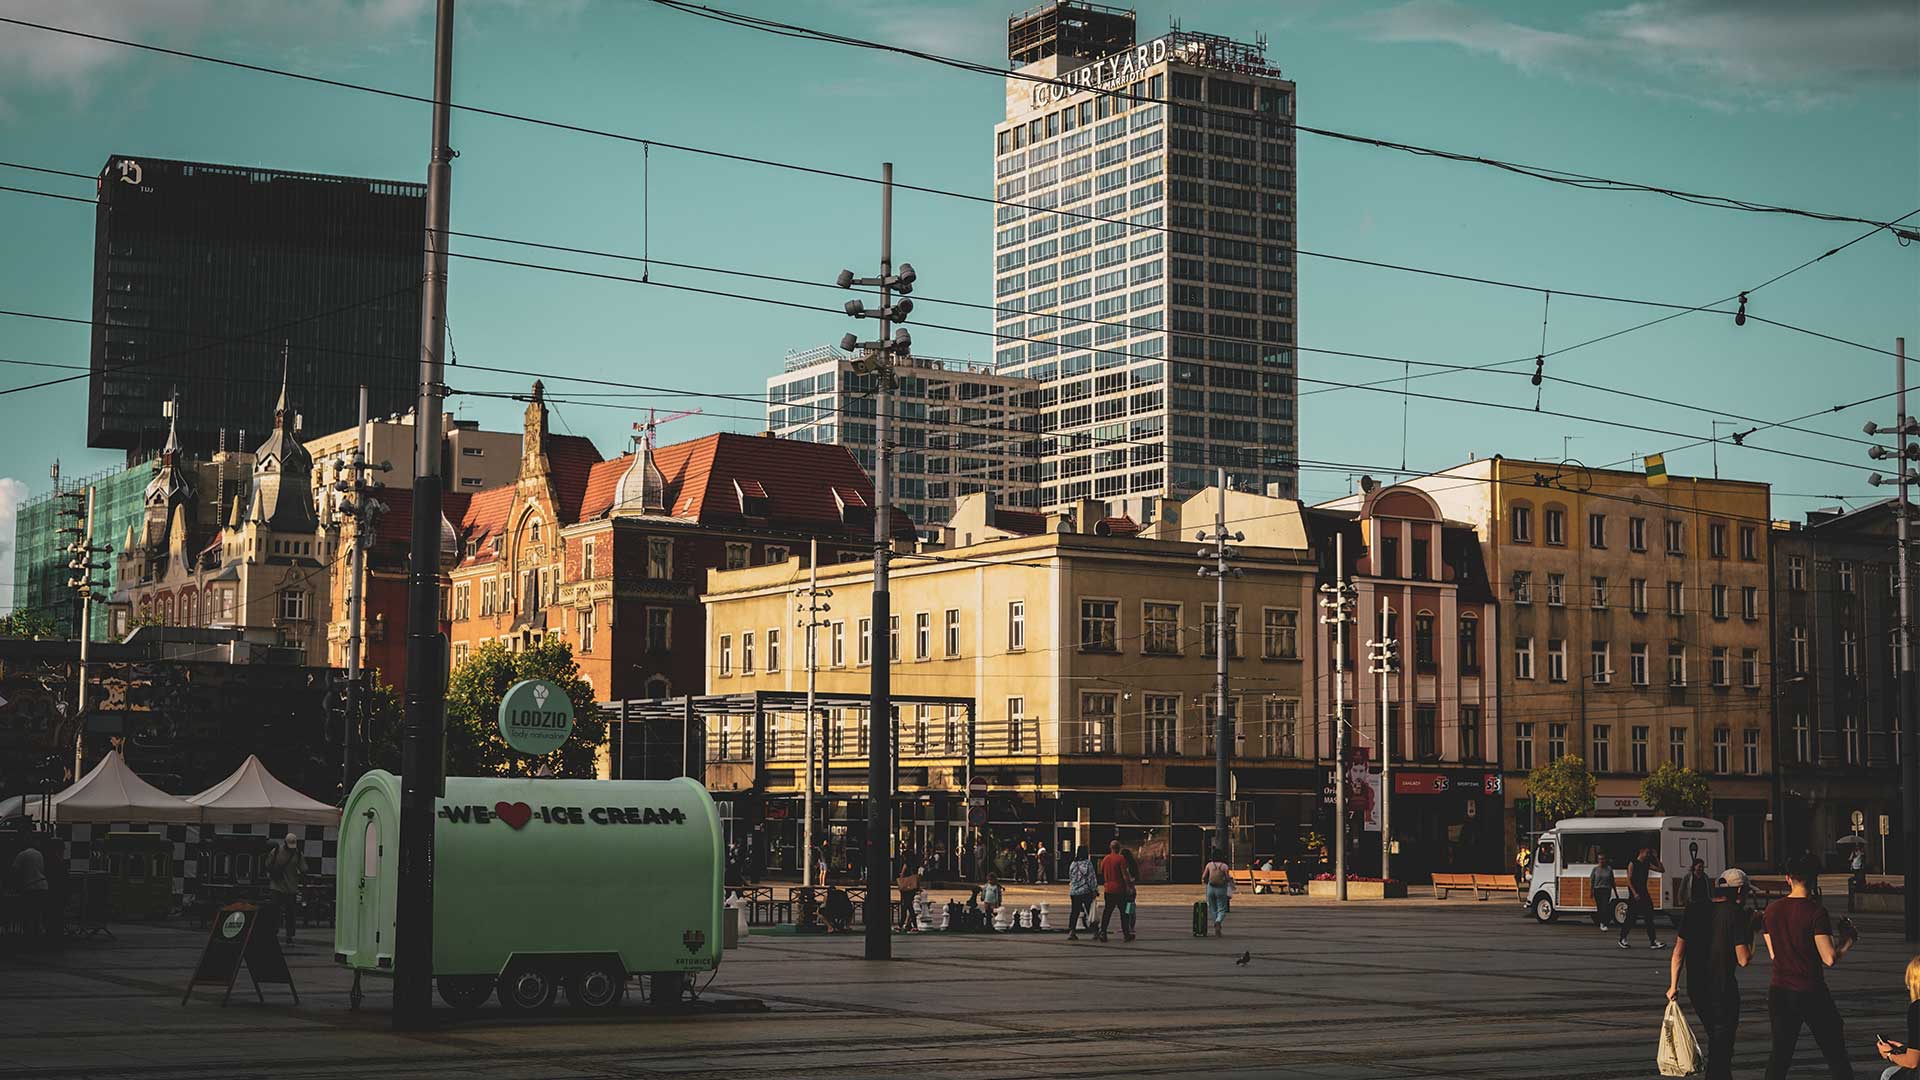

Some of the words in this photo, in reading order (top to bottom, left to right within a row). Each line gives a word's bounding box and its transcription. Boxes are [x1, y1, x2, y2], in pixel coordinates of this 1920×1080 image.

[1036, 39, 1166, 106] COURTYARD
[1104, 68, 1146, 91] MARRIOTT
[512, 710, 567, 728] LODZIO
[1432, 775, 1449, 791] STS
[1486, 776, 1501, 791] STS
[443, 805, 490, 824] WE
[541, 806, 585, 825] ICE
[588, 807, 684, 825] CREAM
